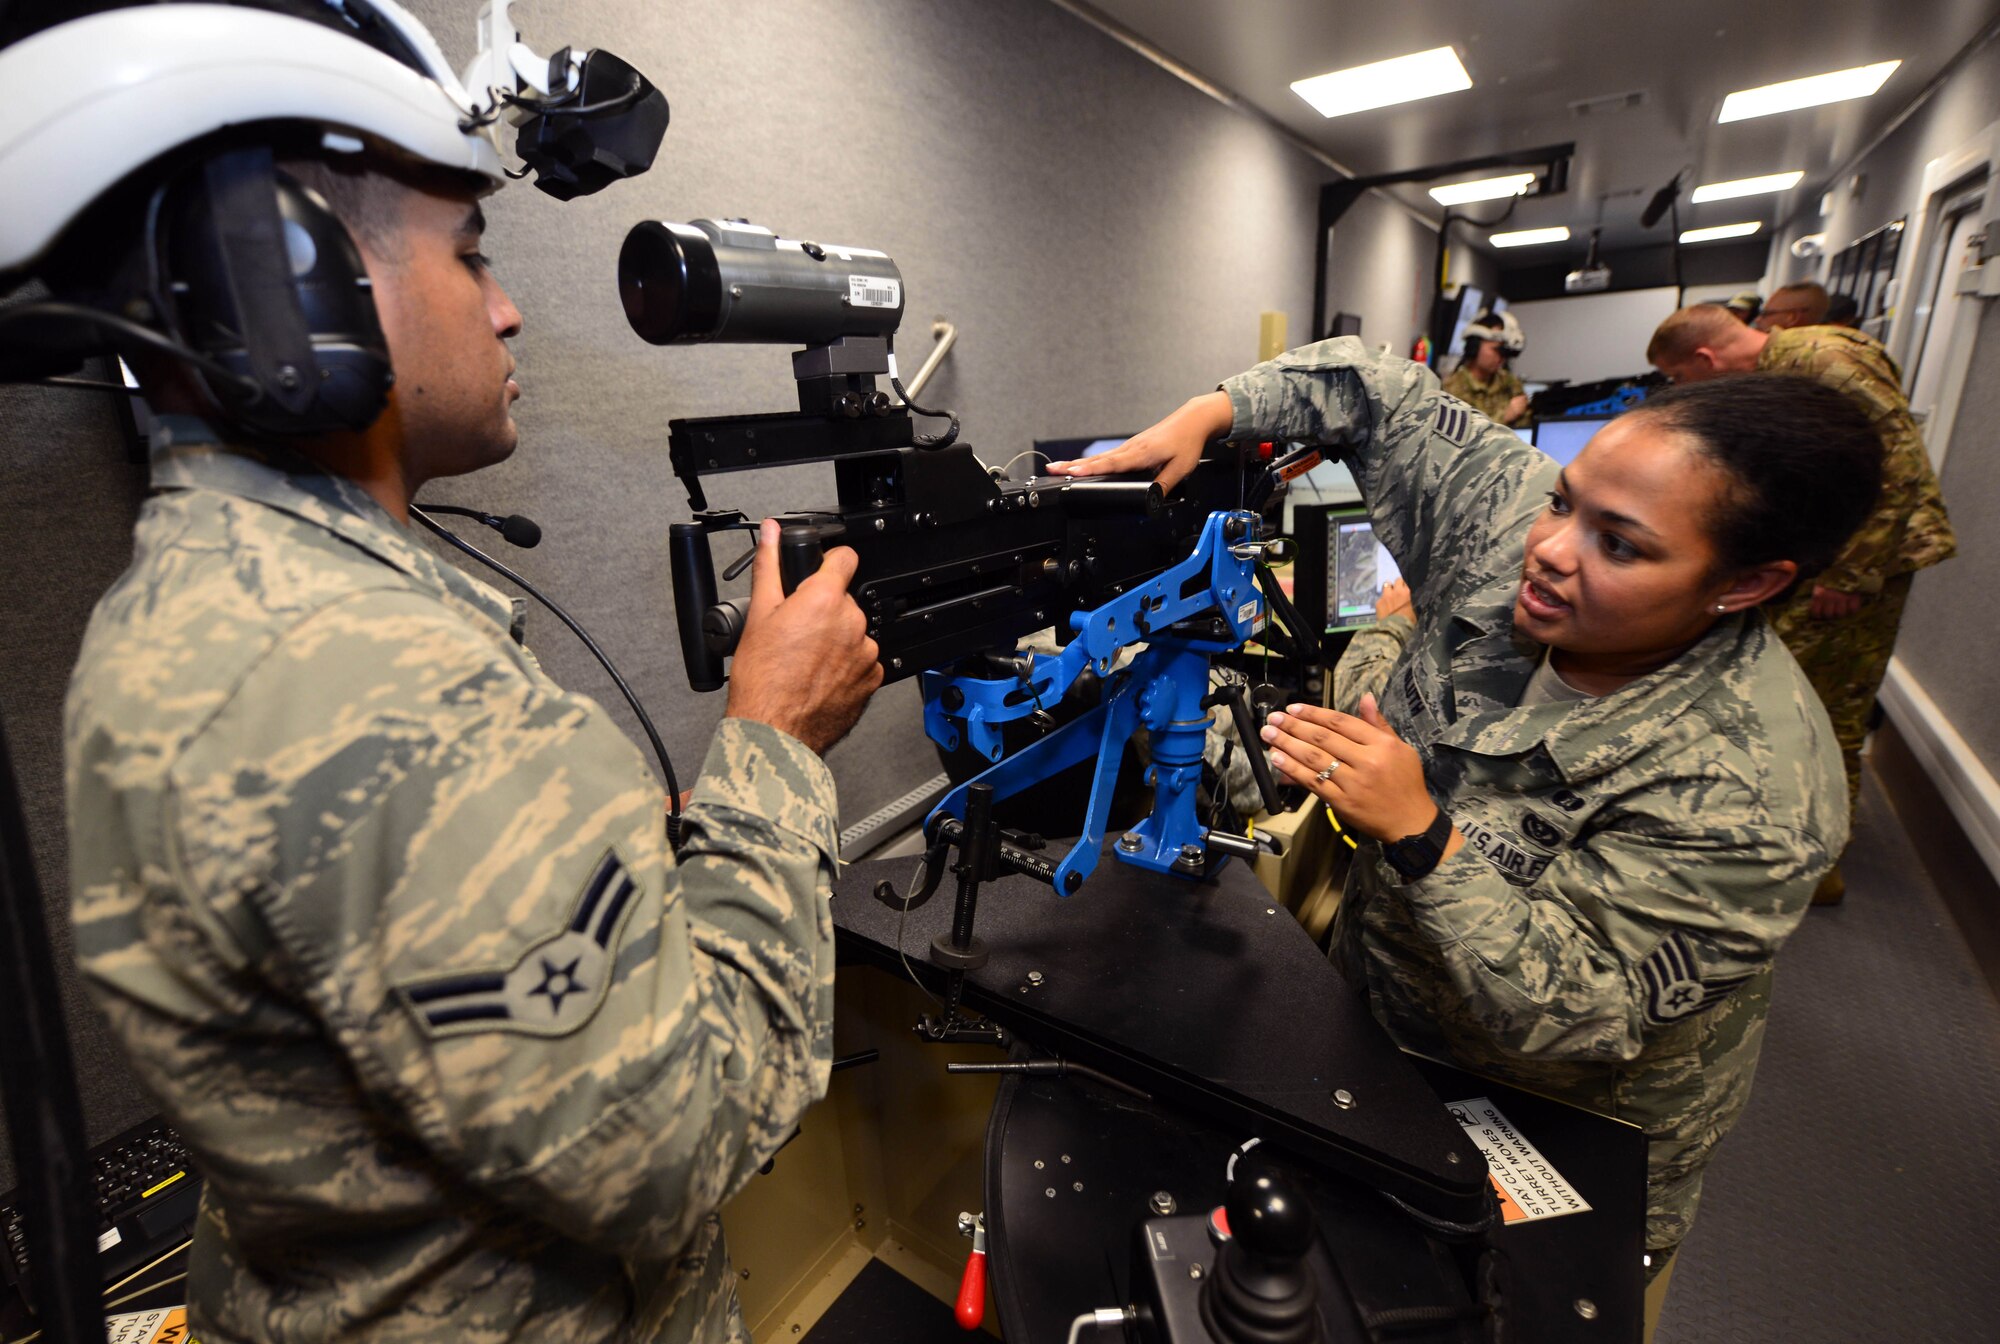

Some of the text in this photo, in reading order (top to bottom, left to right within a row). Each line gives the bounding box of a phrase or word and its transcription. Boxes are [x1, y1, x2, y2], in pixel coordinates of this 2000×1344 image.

[1487, 842, 1525, 875] AIR
[1482, 1129, 1561, 1212] TURRET MOVES
[1482, 1148, 1545, 1215] STAY CLEAR
[1484, 1109, 1580, 1210] WITHOUT WARNING
